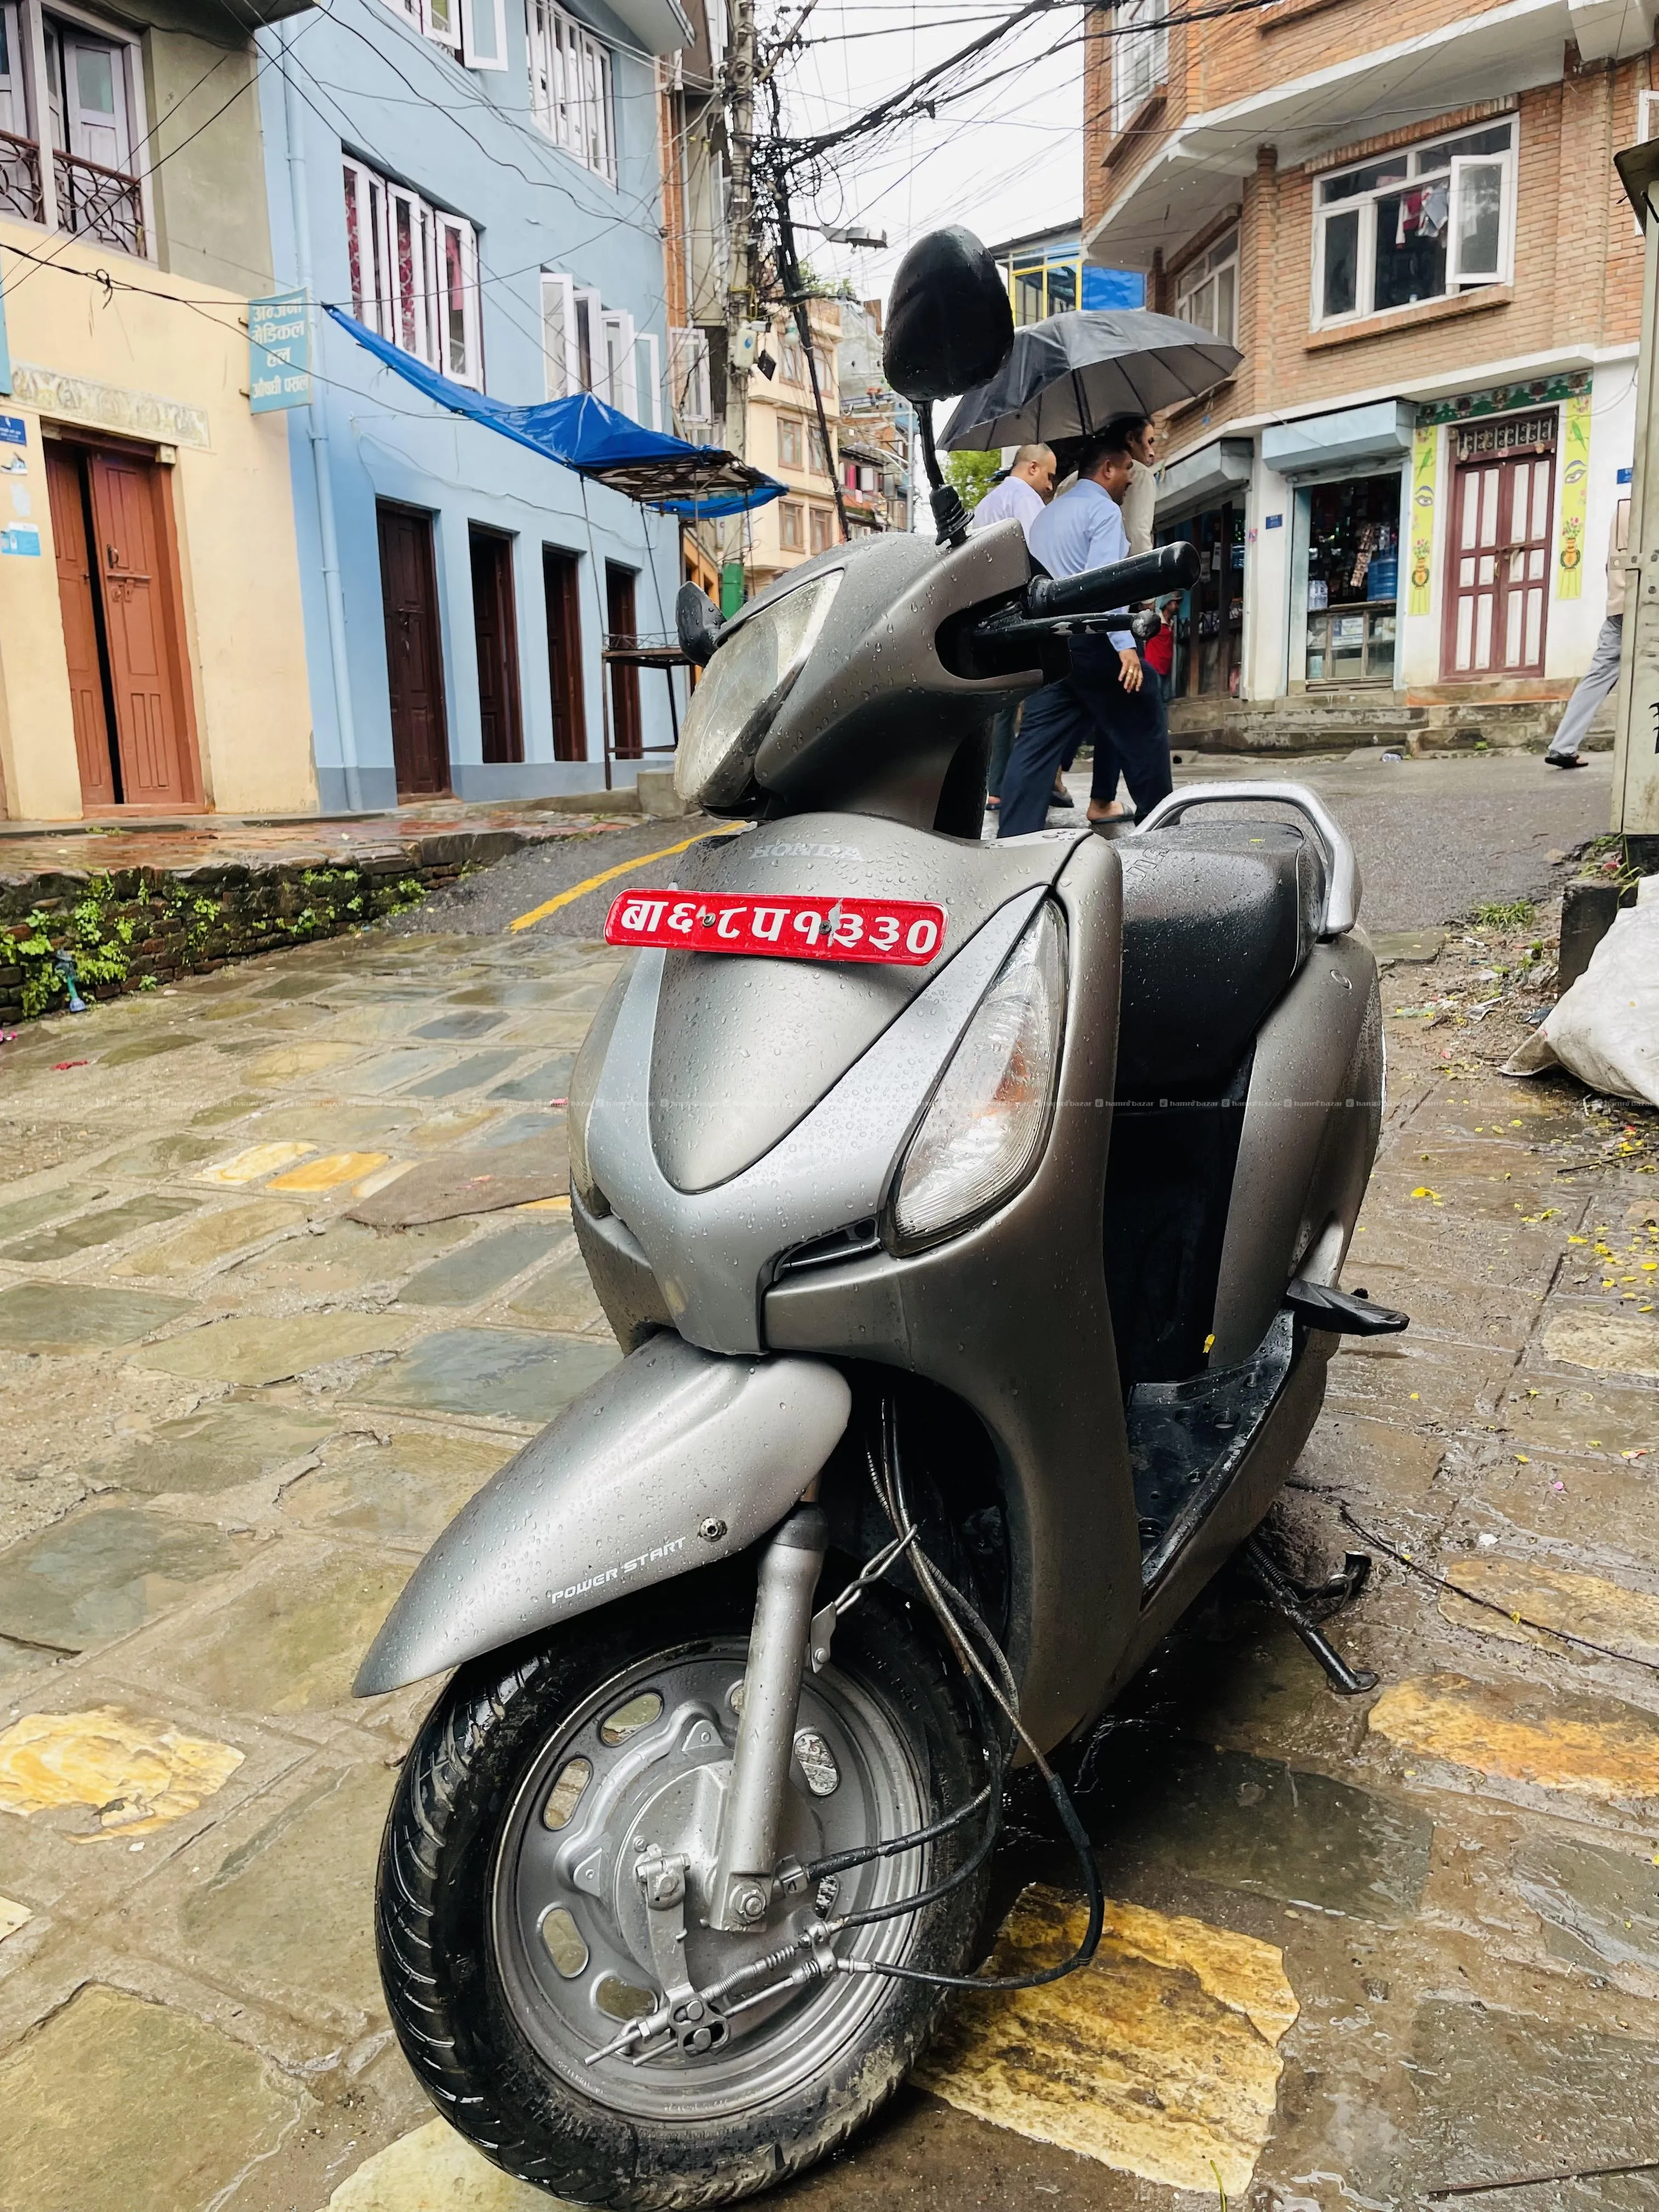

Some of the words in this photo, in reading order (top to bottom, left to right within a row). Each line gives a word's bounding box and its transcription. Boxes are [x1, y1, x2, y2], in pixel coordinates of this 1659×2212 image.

[252, 321, 304, 345] मेडिकल
[748, 843, 865, 862] HONDA
[551, 1568, 618, 1604] POWER
[623, 1537, 686, 1573] START
